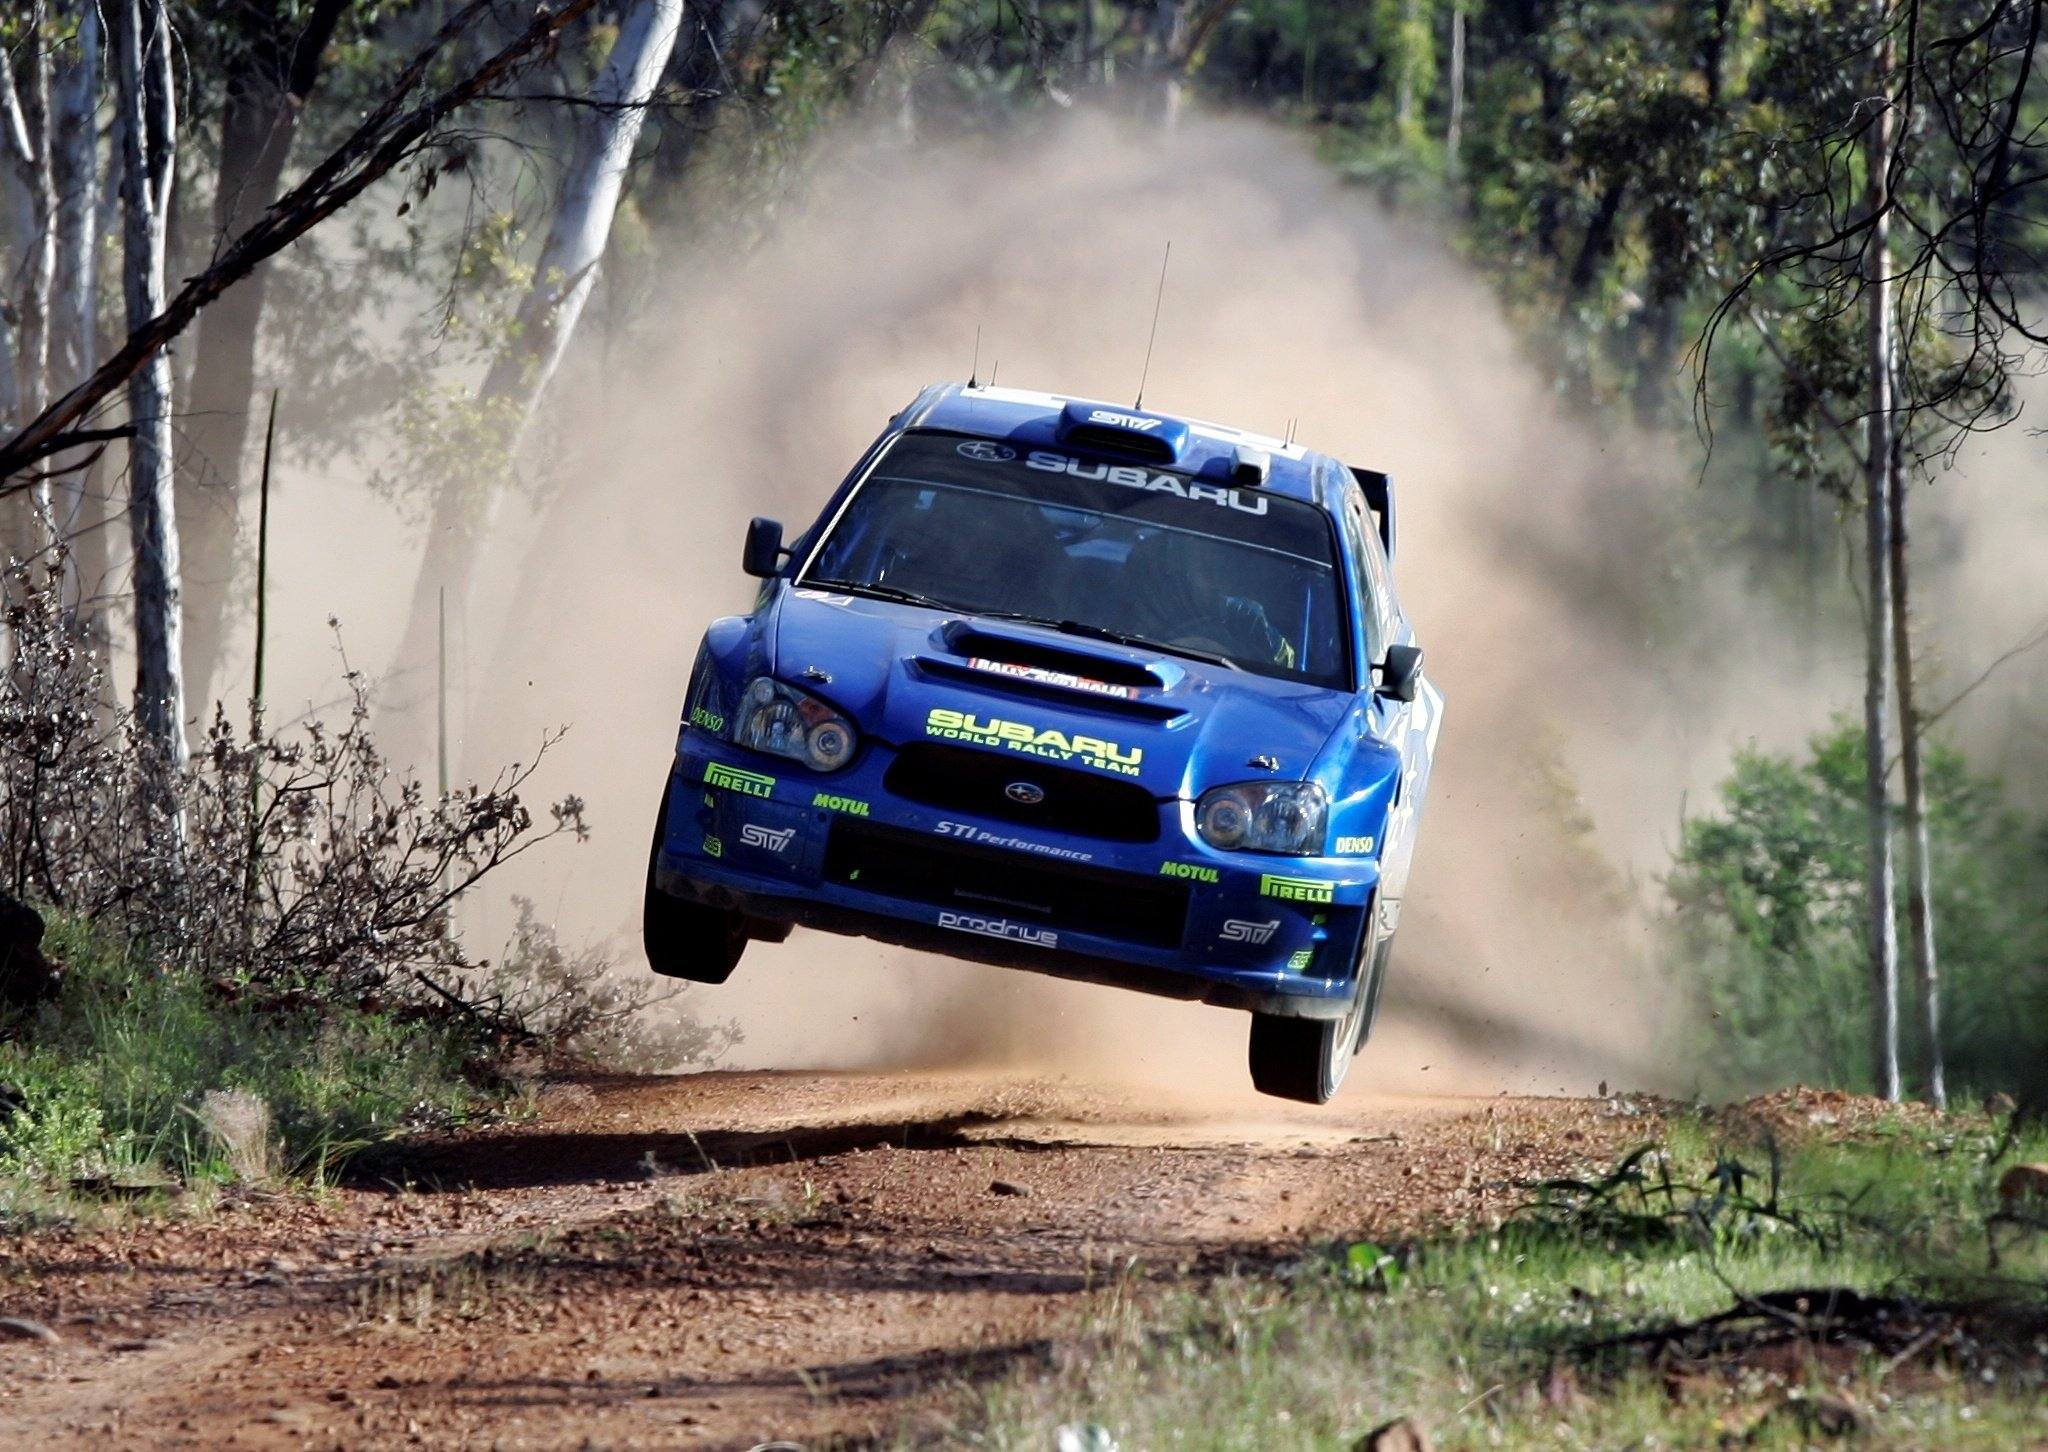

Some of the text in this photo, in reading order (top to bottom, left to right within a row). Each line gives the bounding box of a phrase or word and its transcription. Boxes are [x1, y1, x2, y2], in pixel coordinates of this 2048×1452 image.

[1025, 450, 1268, 516] SUBARU
[691, 707, 724, 731] DENSO
[927, 708, 1142, 765] SUBARU
[925, 726, 1140, 777] WORLD RALLY TEAM
[703, 761, 776, 798] PIRELLI
[812, 793, 870, 817] MOTUL
[934, 821, 1093, 862] STI Performance
[1335, 836, 1374, 854] DENSO
[1160, 861, 1219, 883] MOTUL
[1260, 873, 1334, 903] PIRELLI
[938, 912, 1058, 948] prodrive
